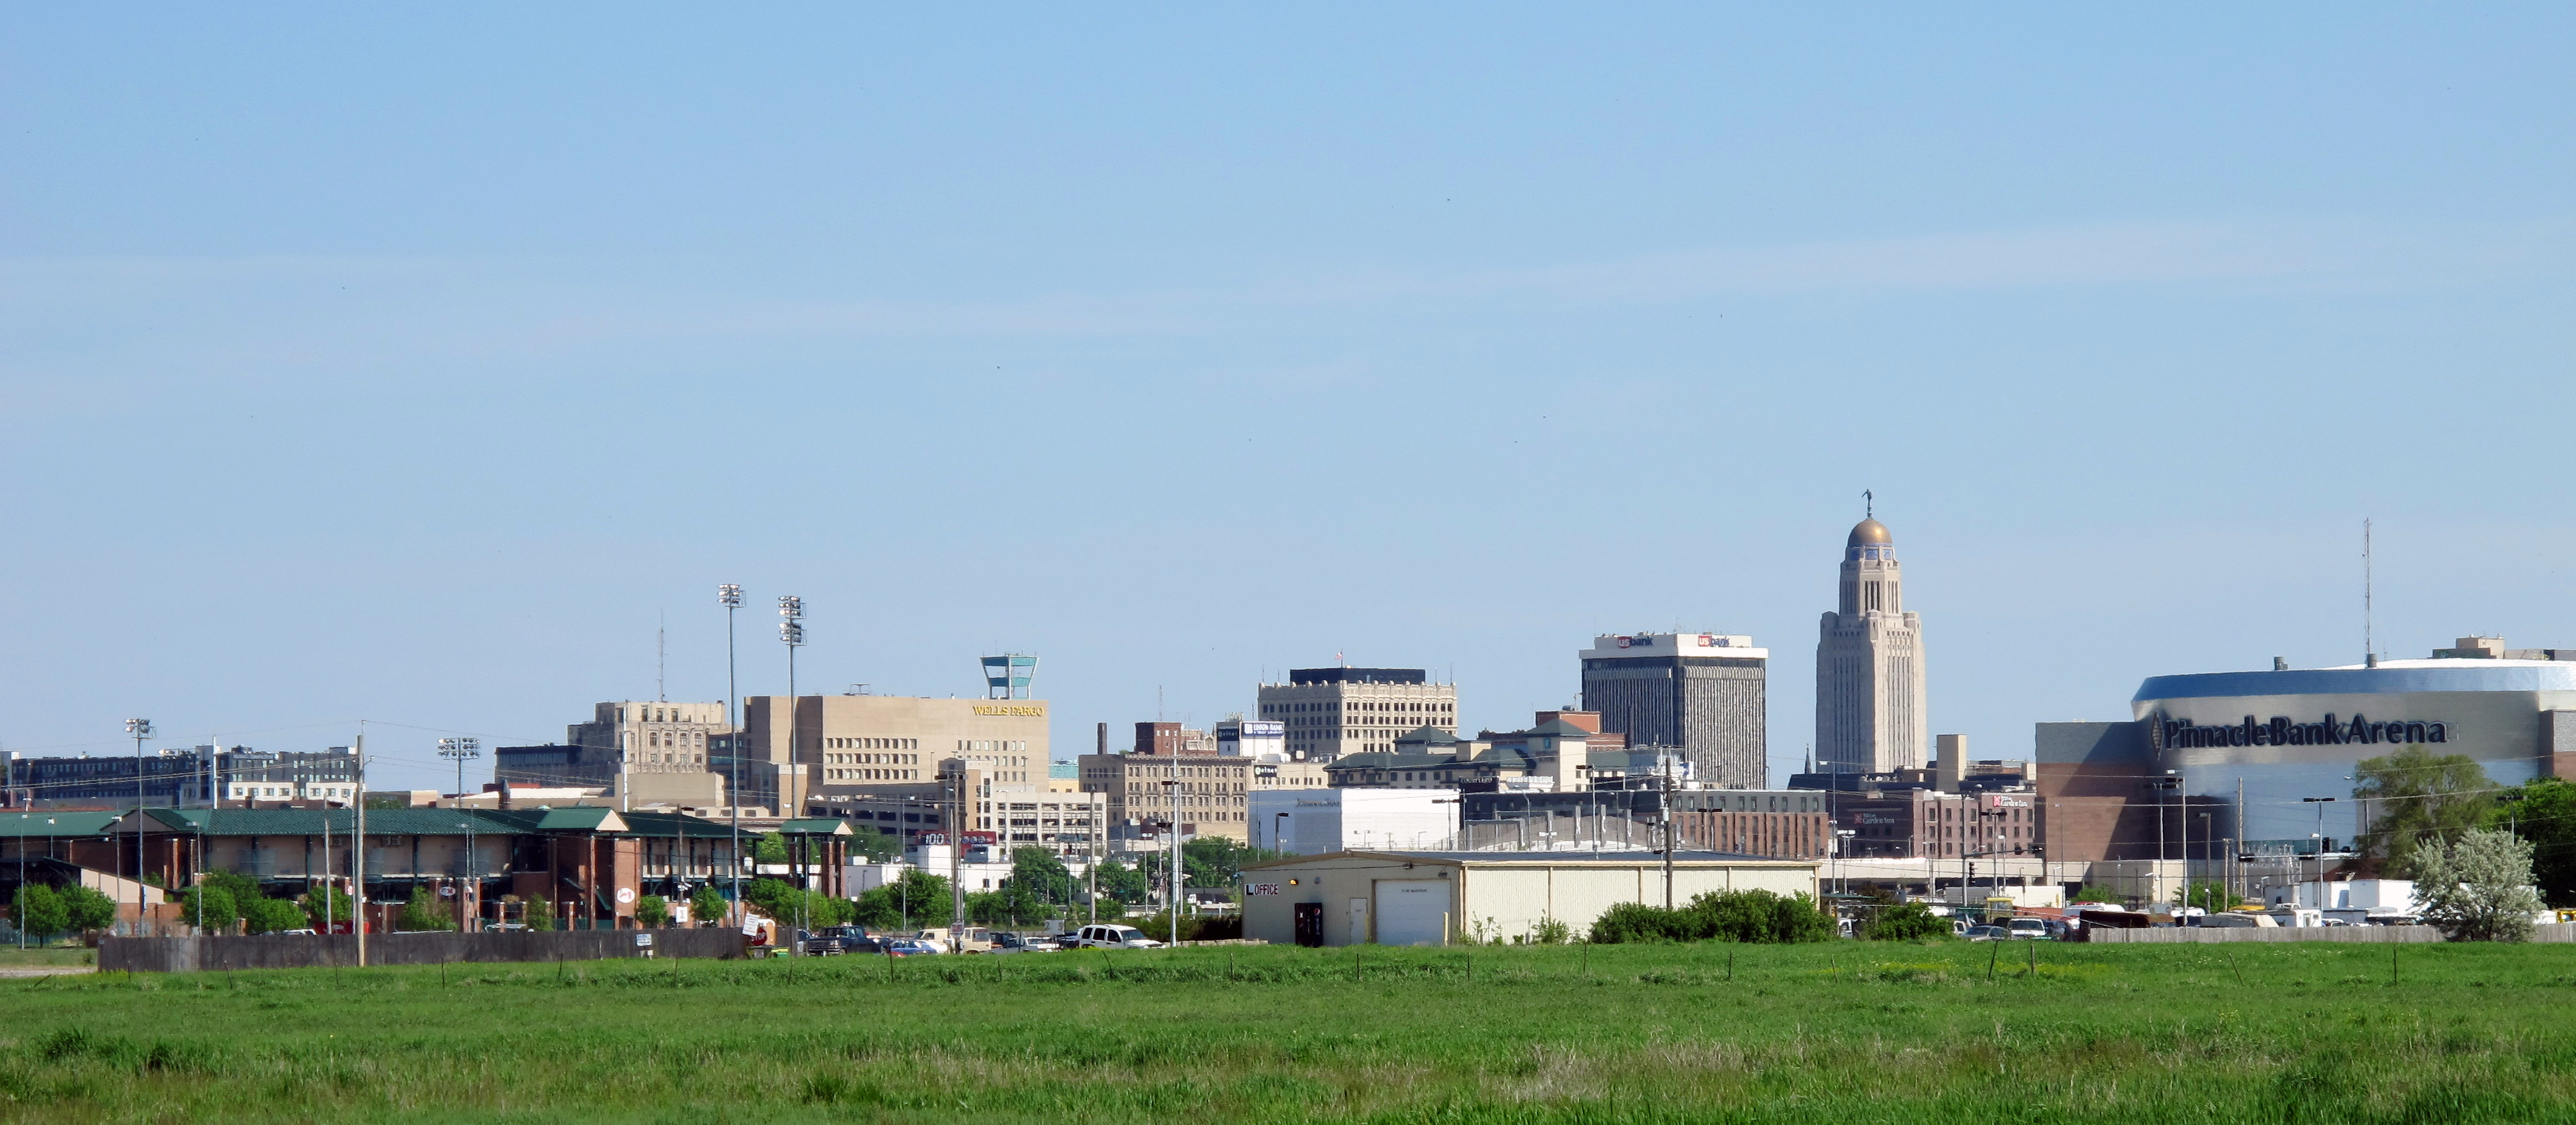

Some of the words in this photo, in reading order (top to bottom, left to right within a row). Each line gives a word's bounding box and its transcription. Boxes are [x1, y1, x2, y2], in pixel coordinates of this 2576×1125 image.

[972, 706, 1008, 715] WELLS
[1010, 706, 1045, 717] FARGO
[1255, 884, 1277, 895] OFFICE
